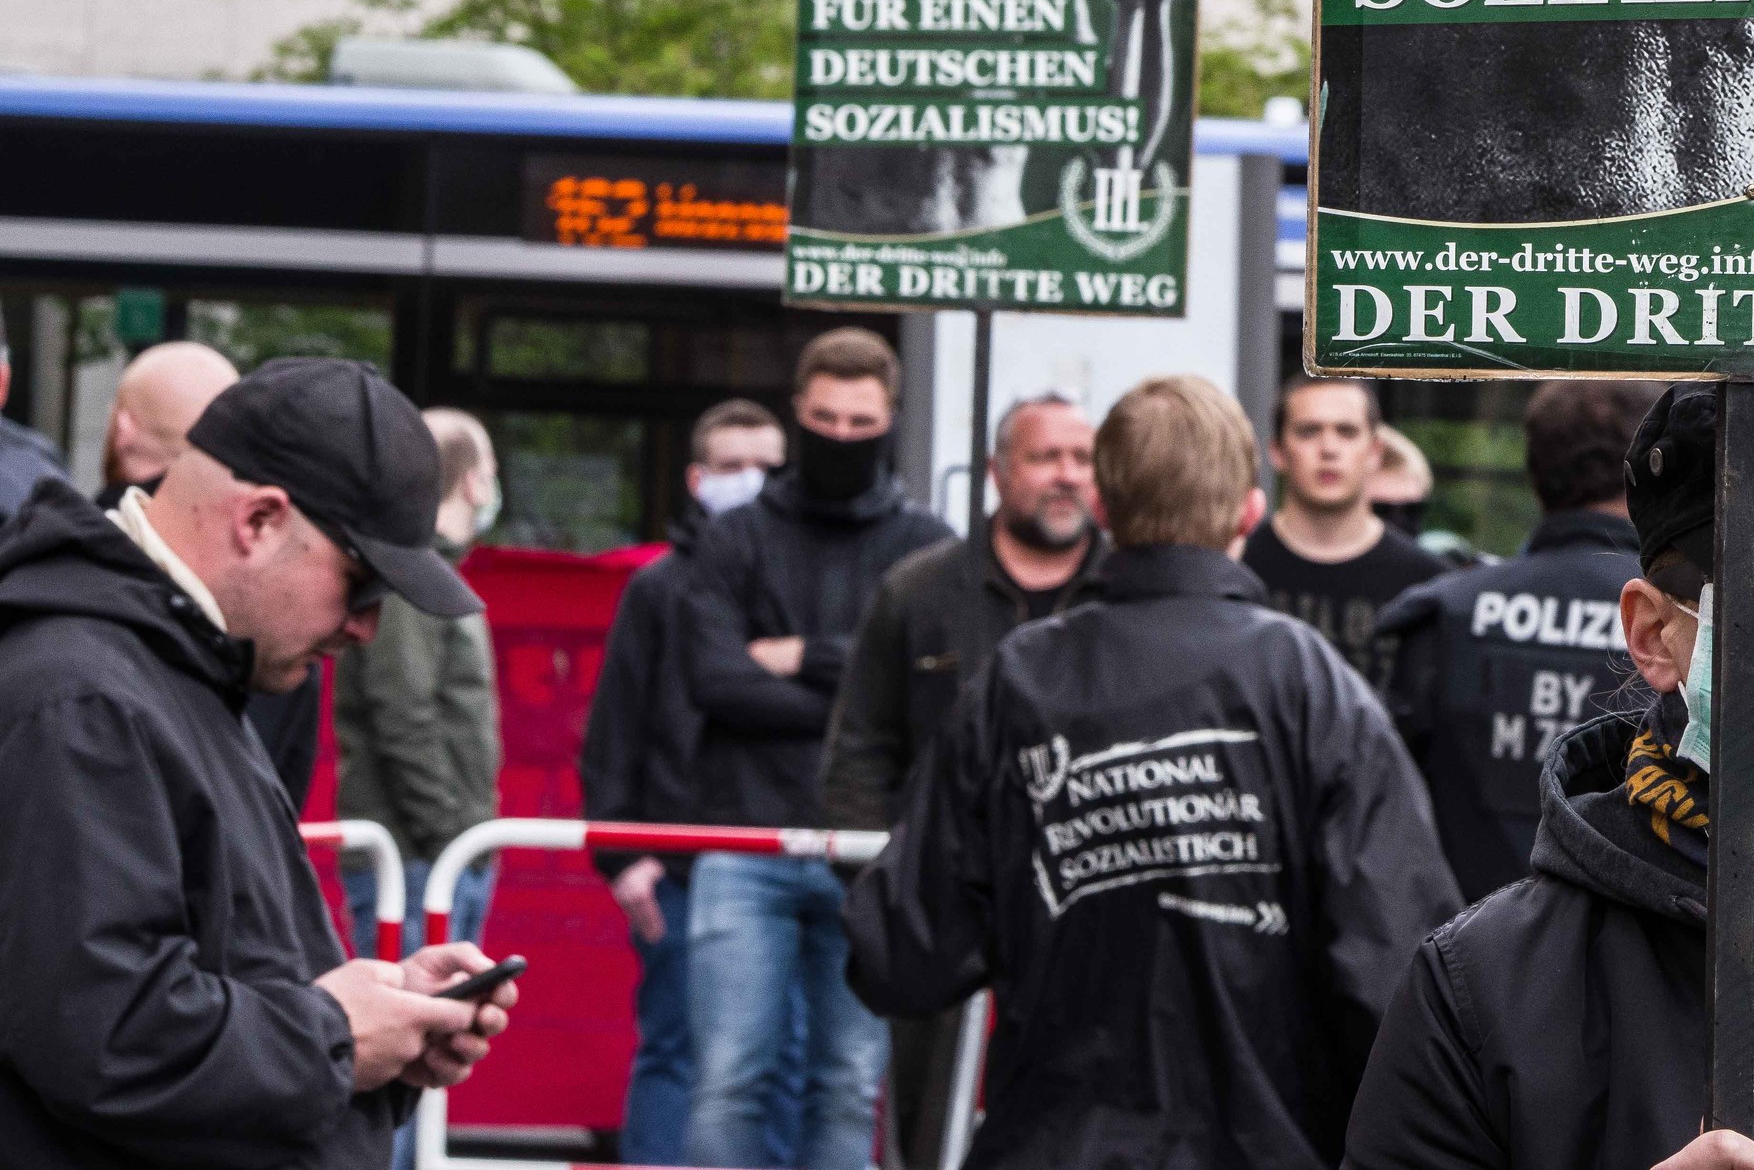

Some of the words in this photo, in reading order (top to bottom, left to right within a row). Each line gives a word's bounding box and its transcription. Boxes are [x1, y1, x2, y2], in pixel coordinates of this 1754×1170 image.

[811, 49, 1097, 87] DEUTSCHEN
[805, 104, 1139, 143] SOZIALISMUS!
[793, 261, 885, 295] DER
[898, 267, 1064, 302] DRITTE
[1075, 271, 1177, 306] WEG
[1331, 284, 1527, 347] DER
[1530, 670, 1594, 720] BY
[1491, 714, 1526, 761] M
[1066, 754, 1223, 806] NATIONAL
